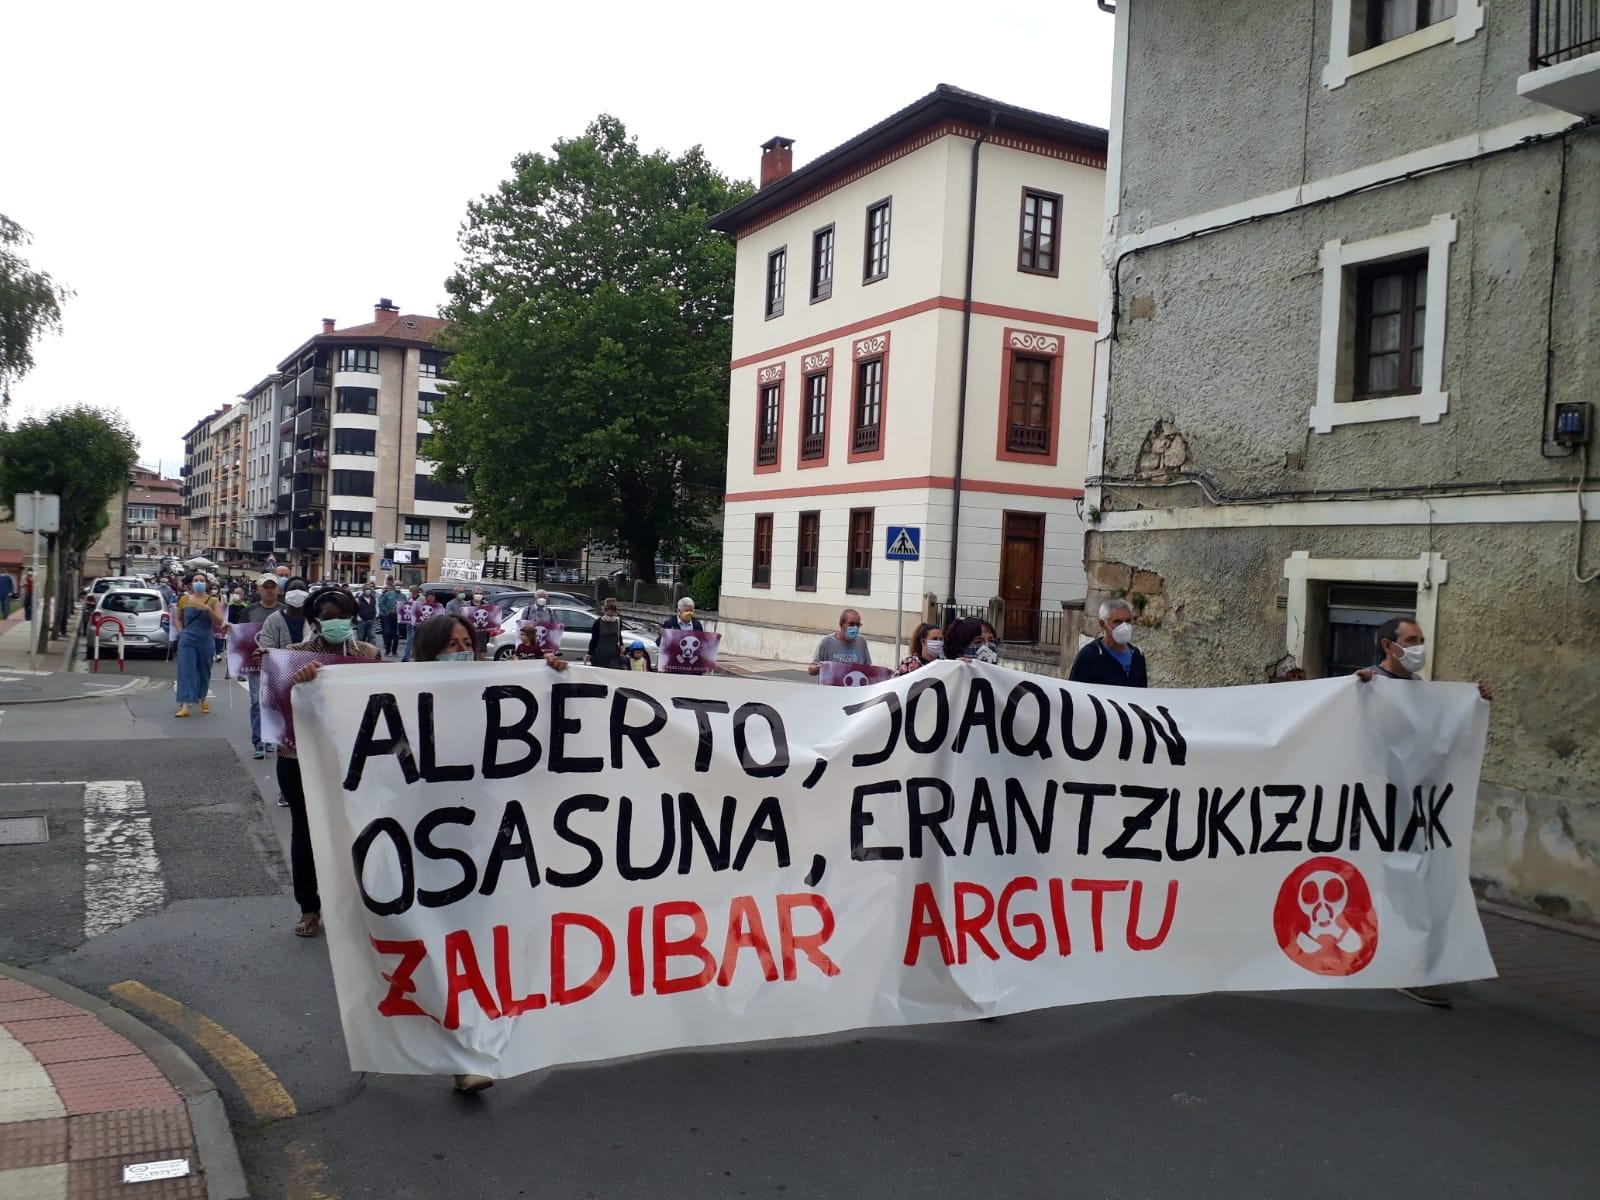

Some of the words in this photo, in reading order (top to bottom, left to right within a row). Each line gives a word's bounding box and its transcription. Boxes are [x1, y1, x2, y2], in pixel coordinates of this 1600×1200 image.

[343, 683, 828, 790] ALBERTO,
[843, 677, 1187, 766] JOAQUIN
[351, 793, 827, 915] OSASUNA,
[850, 777, 1455, 862] ERANTZUKIZUNAK
[369, 893, 841, 1030] ZALDIBAR
[904, 876, 1179, 966] ARGITU
